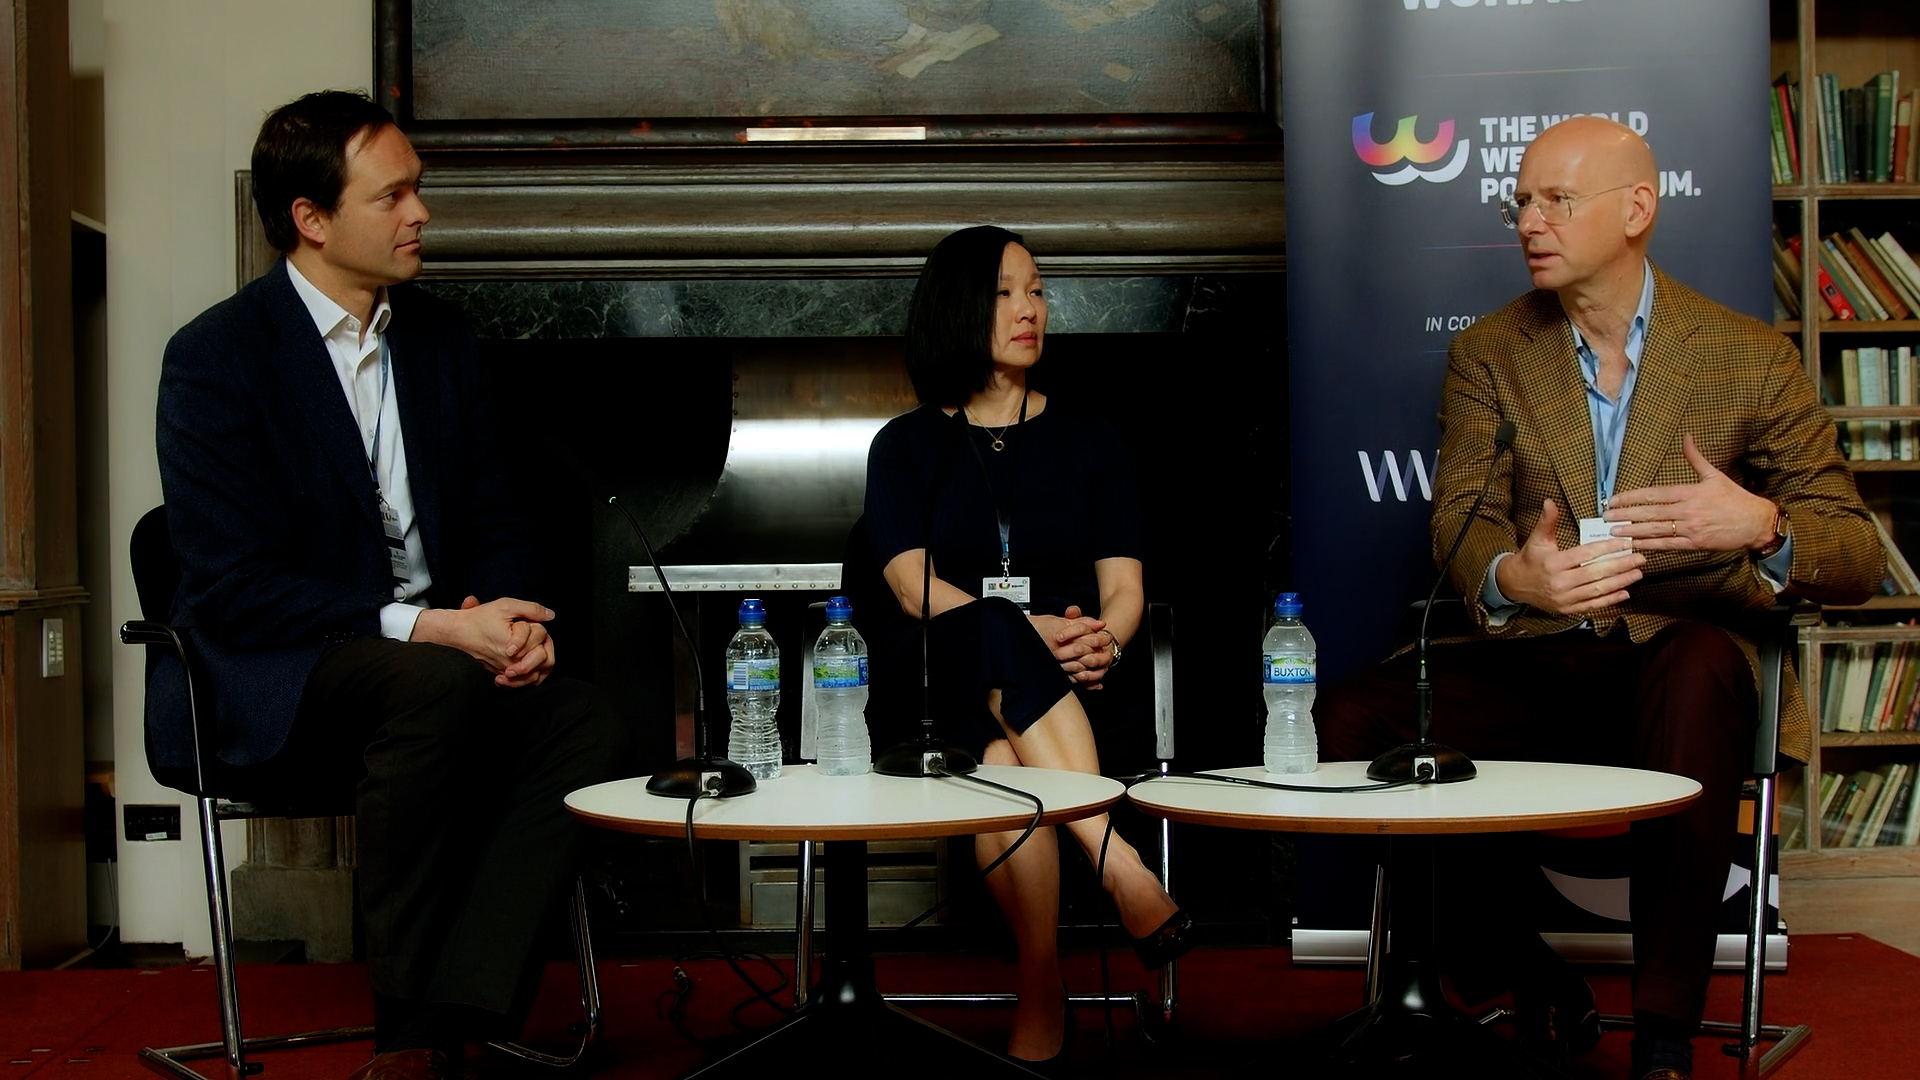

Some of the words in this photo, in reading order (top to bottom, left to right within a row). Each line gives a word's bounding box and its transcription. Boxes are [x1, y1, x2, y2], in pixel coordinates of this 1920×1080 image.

[1480, 115, 1537, 143] THE
[1425, 316, 1443, 332] IN
[1274, 667, 1311, 677] BUXTON
